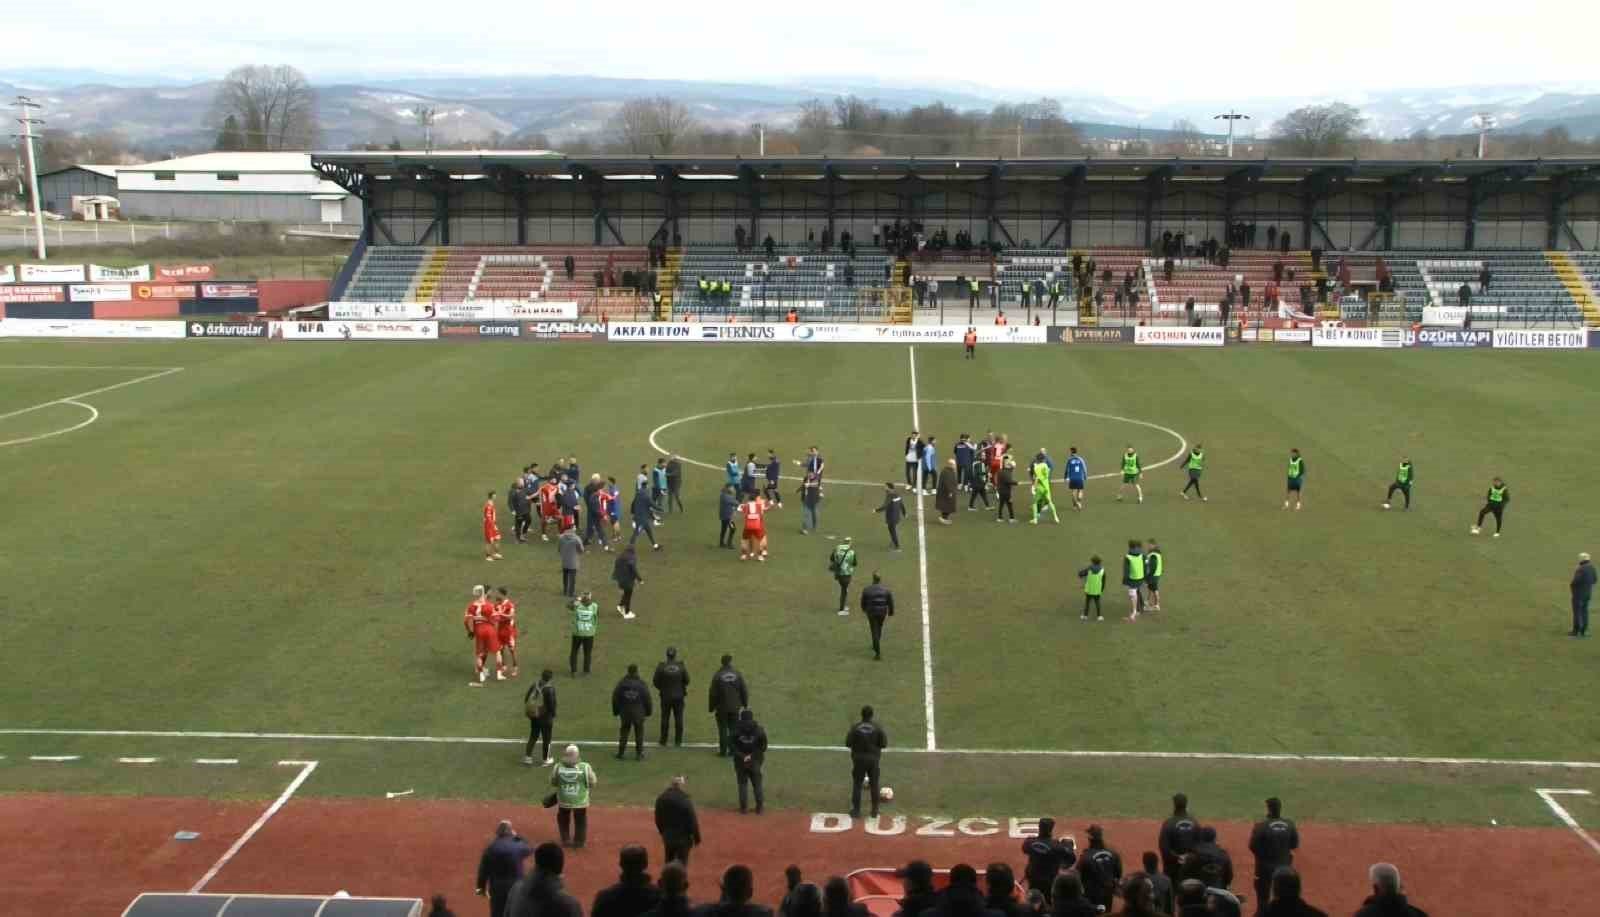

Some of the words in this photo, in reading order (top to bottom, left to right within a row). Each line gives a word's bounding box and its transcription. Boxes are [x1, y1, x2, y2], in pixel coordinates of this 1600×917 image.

[613, 326, 645, 336] AKFA
[650, 326, 690, 336] BETON
[1460, 330, 1490, 342] YAPI
[1548, 332, 1583, 346] BETON
